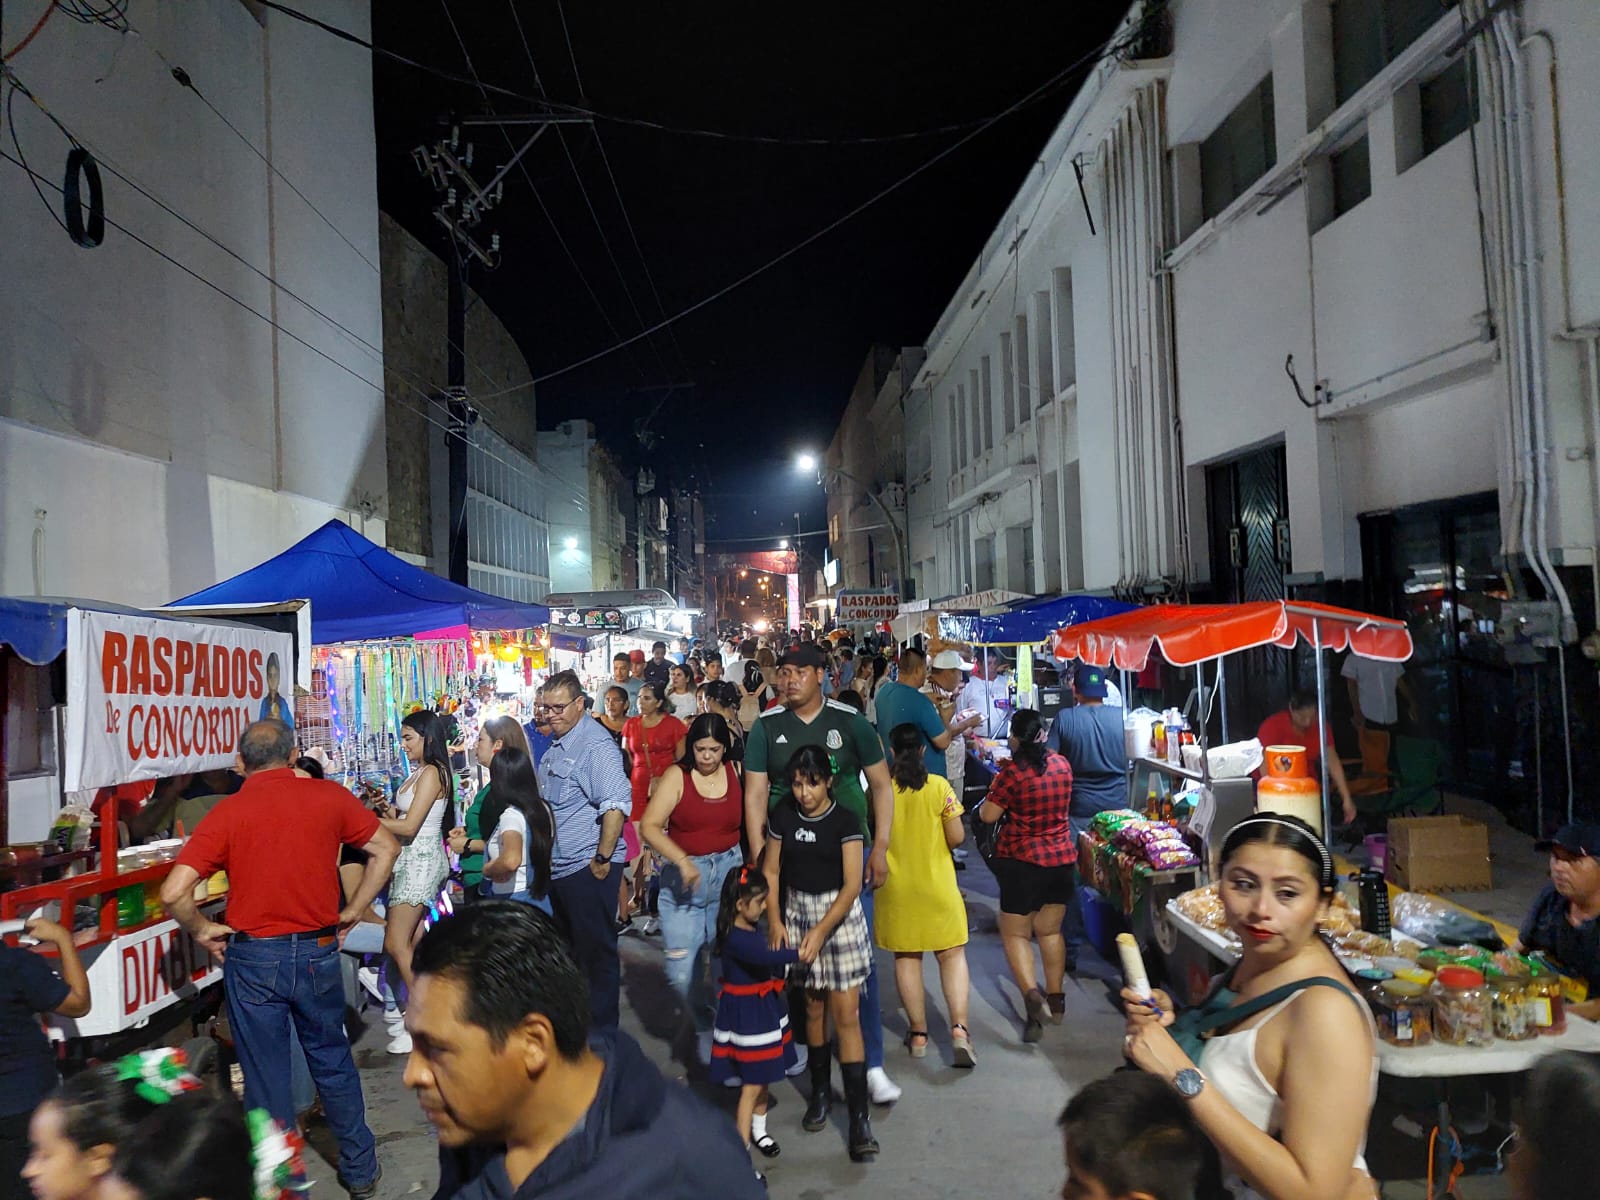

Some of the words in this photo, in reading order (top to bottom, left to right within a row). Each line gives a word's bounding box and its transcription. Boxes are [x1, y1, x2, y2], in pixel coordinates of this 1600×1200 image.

[841, 595, 899, 607] RASPADOS
[102, 630, 263, 700] RASPADOS
[106, 700, 121, 733] De
